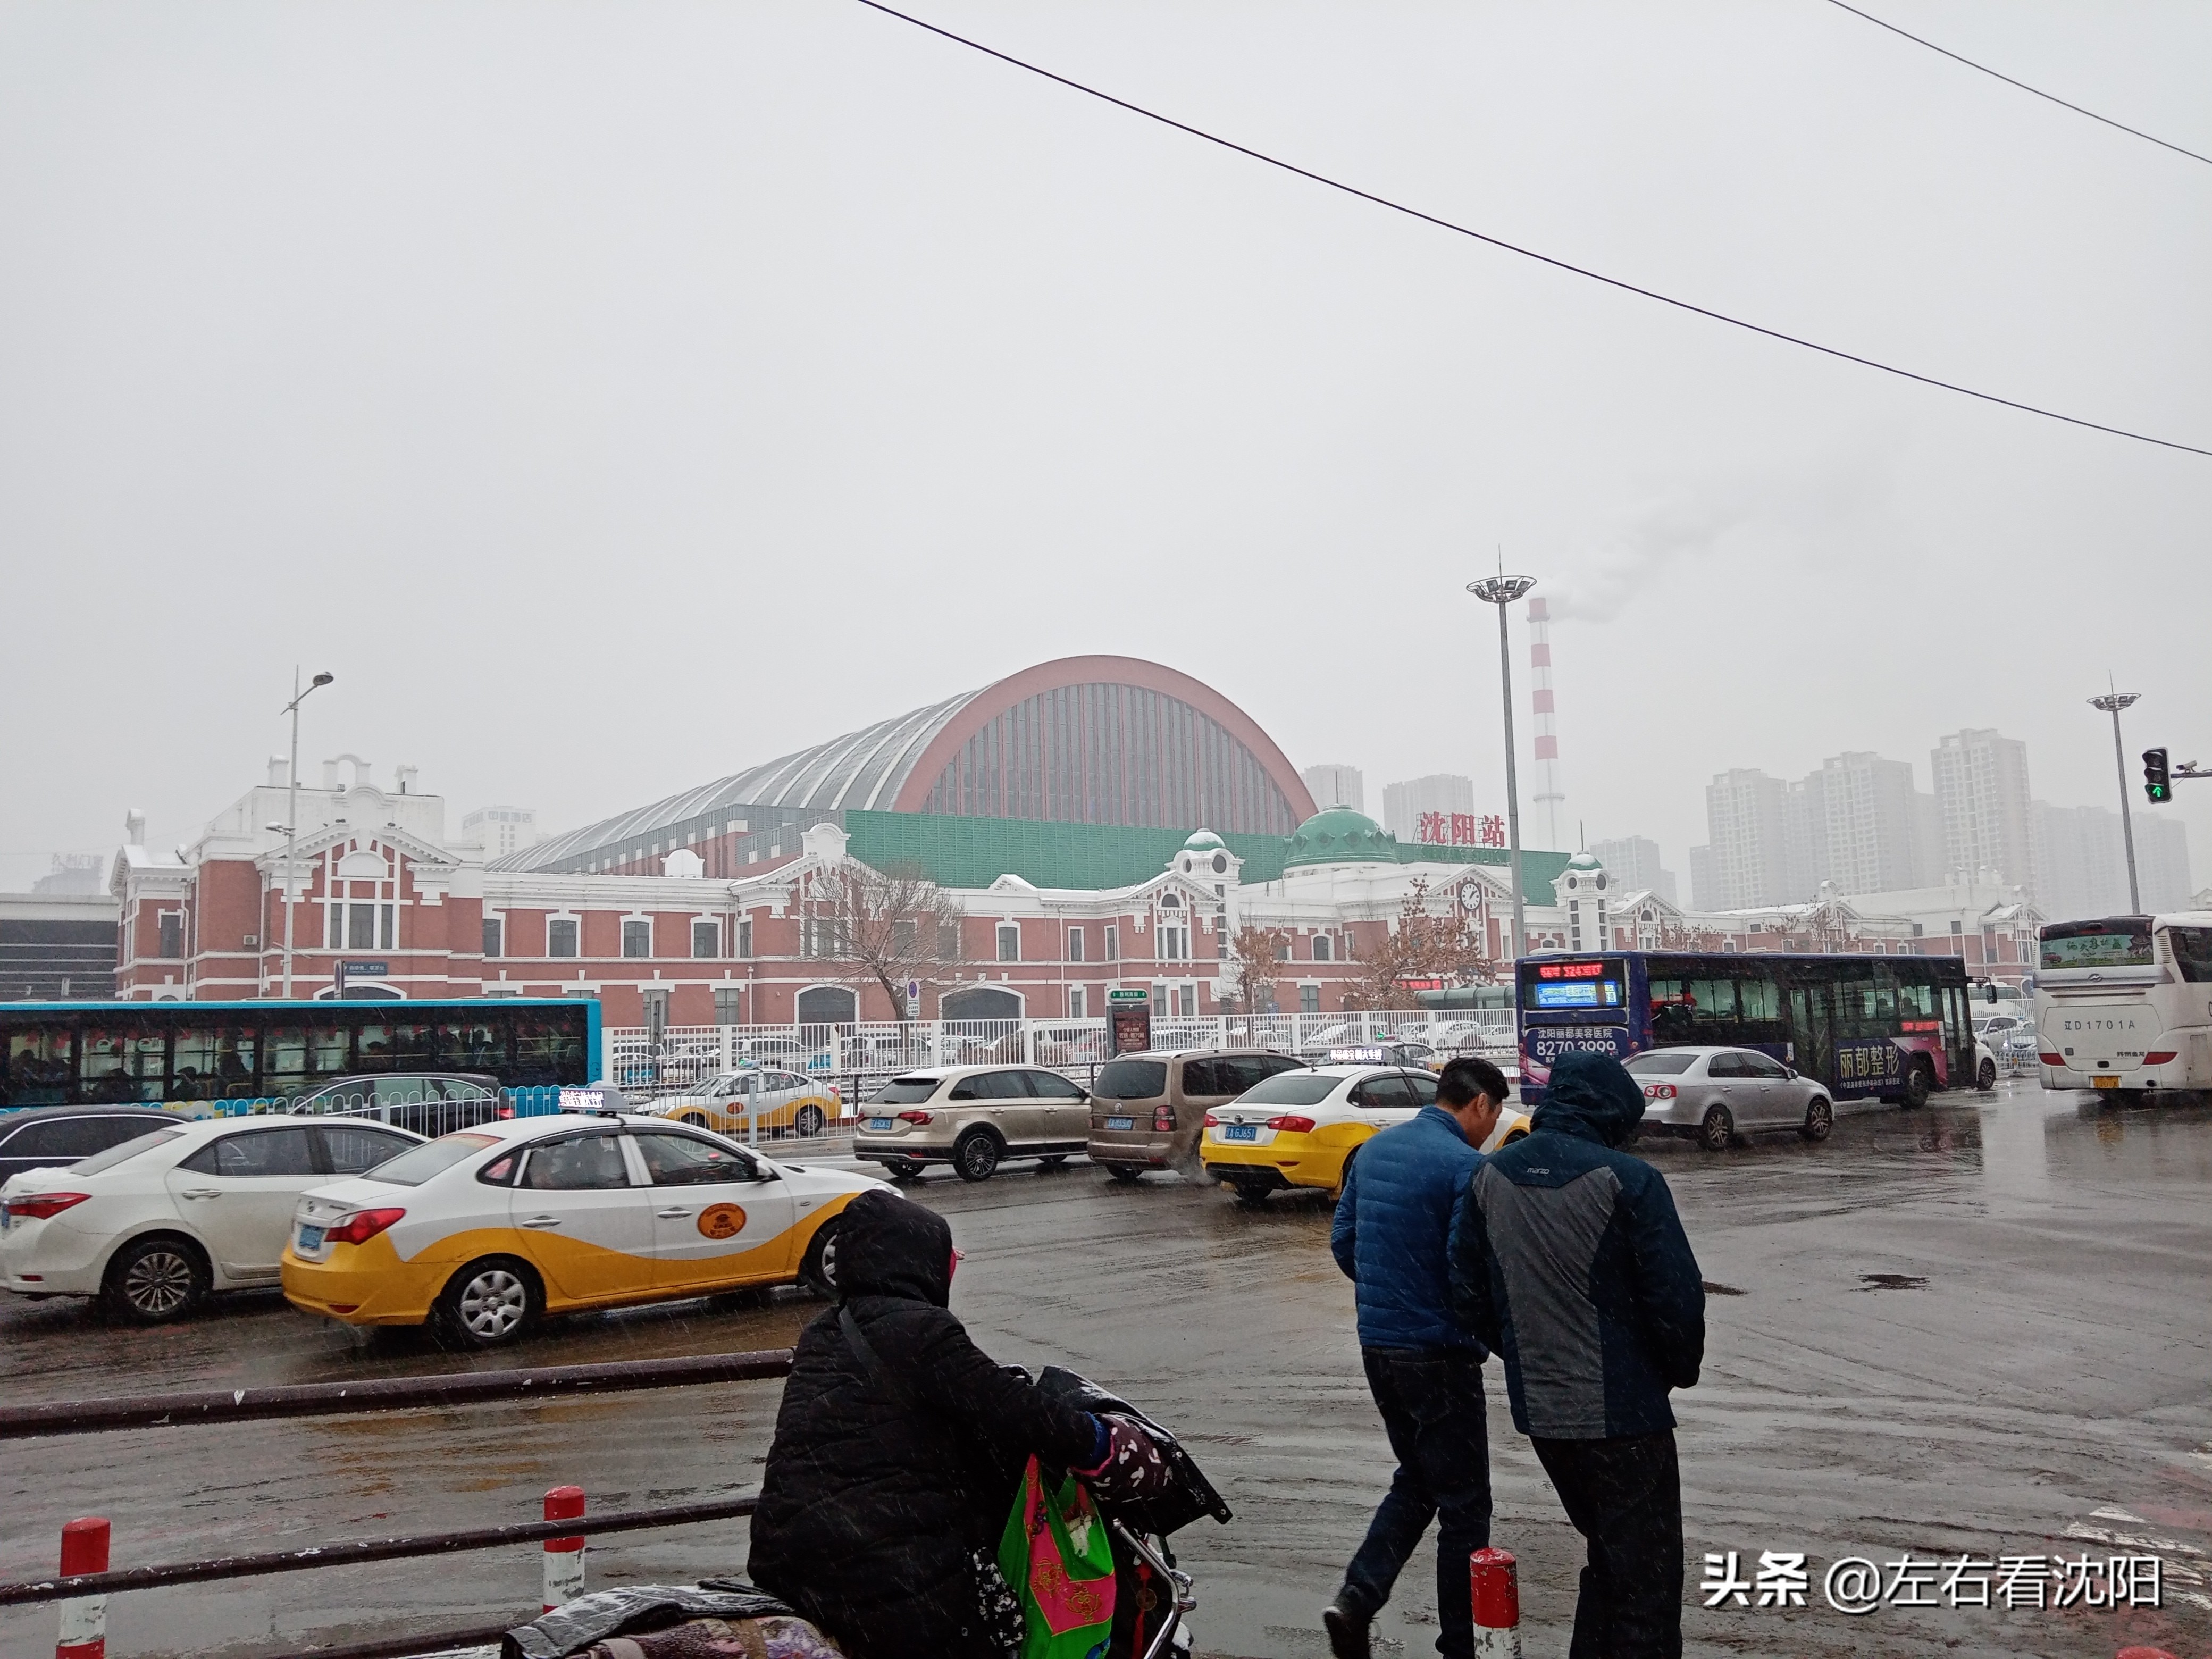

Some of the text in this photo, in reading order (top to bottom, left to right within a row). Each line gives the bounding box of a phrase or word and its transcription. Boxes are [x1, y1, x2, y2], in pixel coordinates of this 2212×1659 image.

[1421, 811, 1505, 847] 沈阳站
[1538, 1028, 1613, 1039] 沈阳丽都美容医院
[1839, 1045, 1900, 1079] 丽都整形
